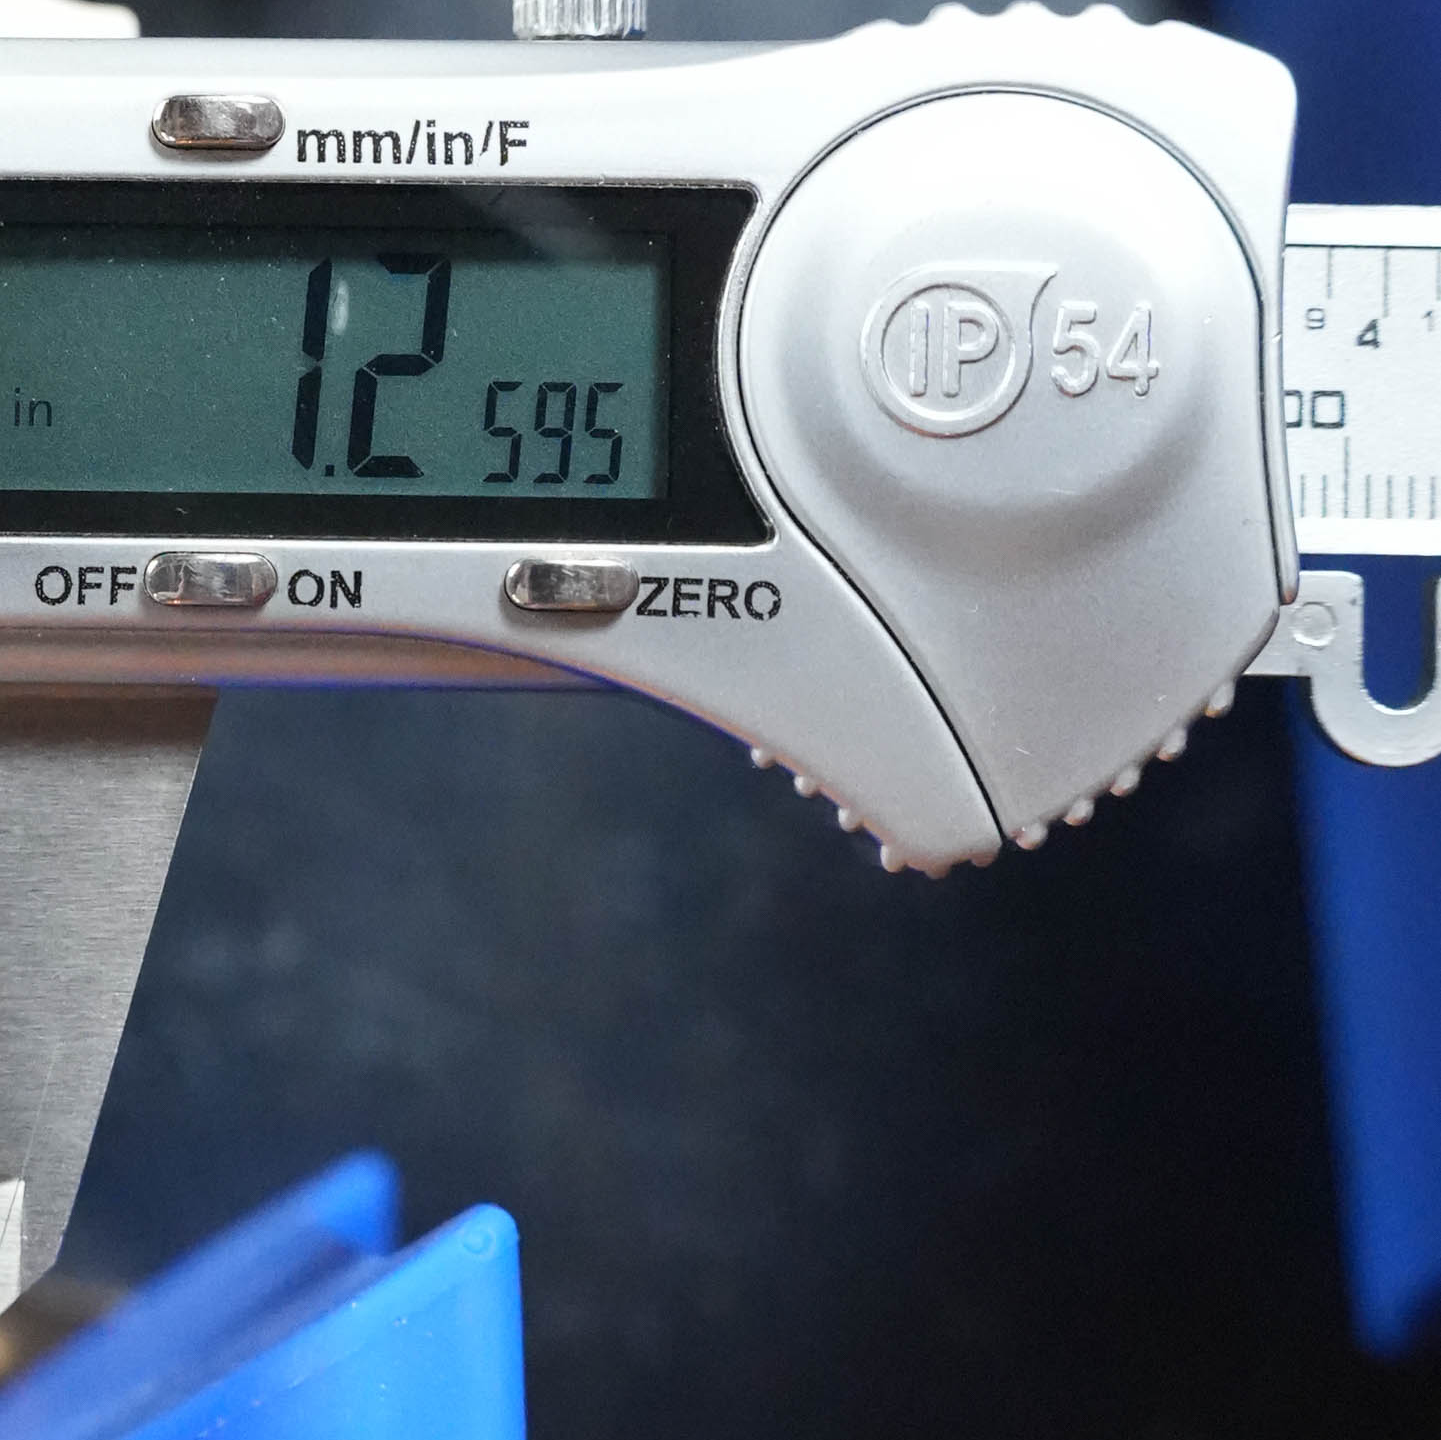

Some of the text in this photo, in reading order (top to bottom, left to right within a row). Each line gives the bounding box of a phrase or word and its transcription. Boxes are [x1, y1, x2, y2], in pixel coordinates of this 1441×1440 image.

[296, 119, 531, 167] mm/in/F
[908, 299, 1160, 398] IP 54
[1355, 318, 1380, 349] 4
[13, 388, 53, 428] in
[1283, 389, 1346, 430] 00
[34, 564, 363, 609] OFF ON
[635, 575, 783, 622] ZERO
